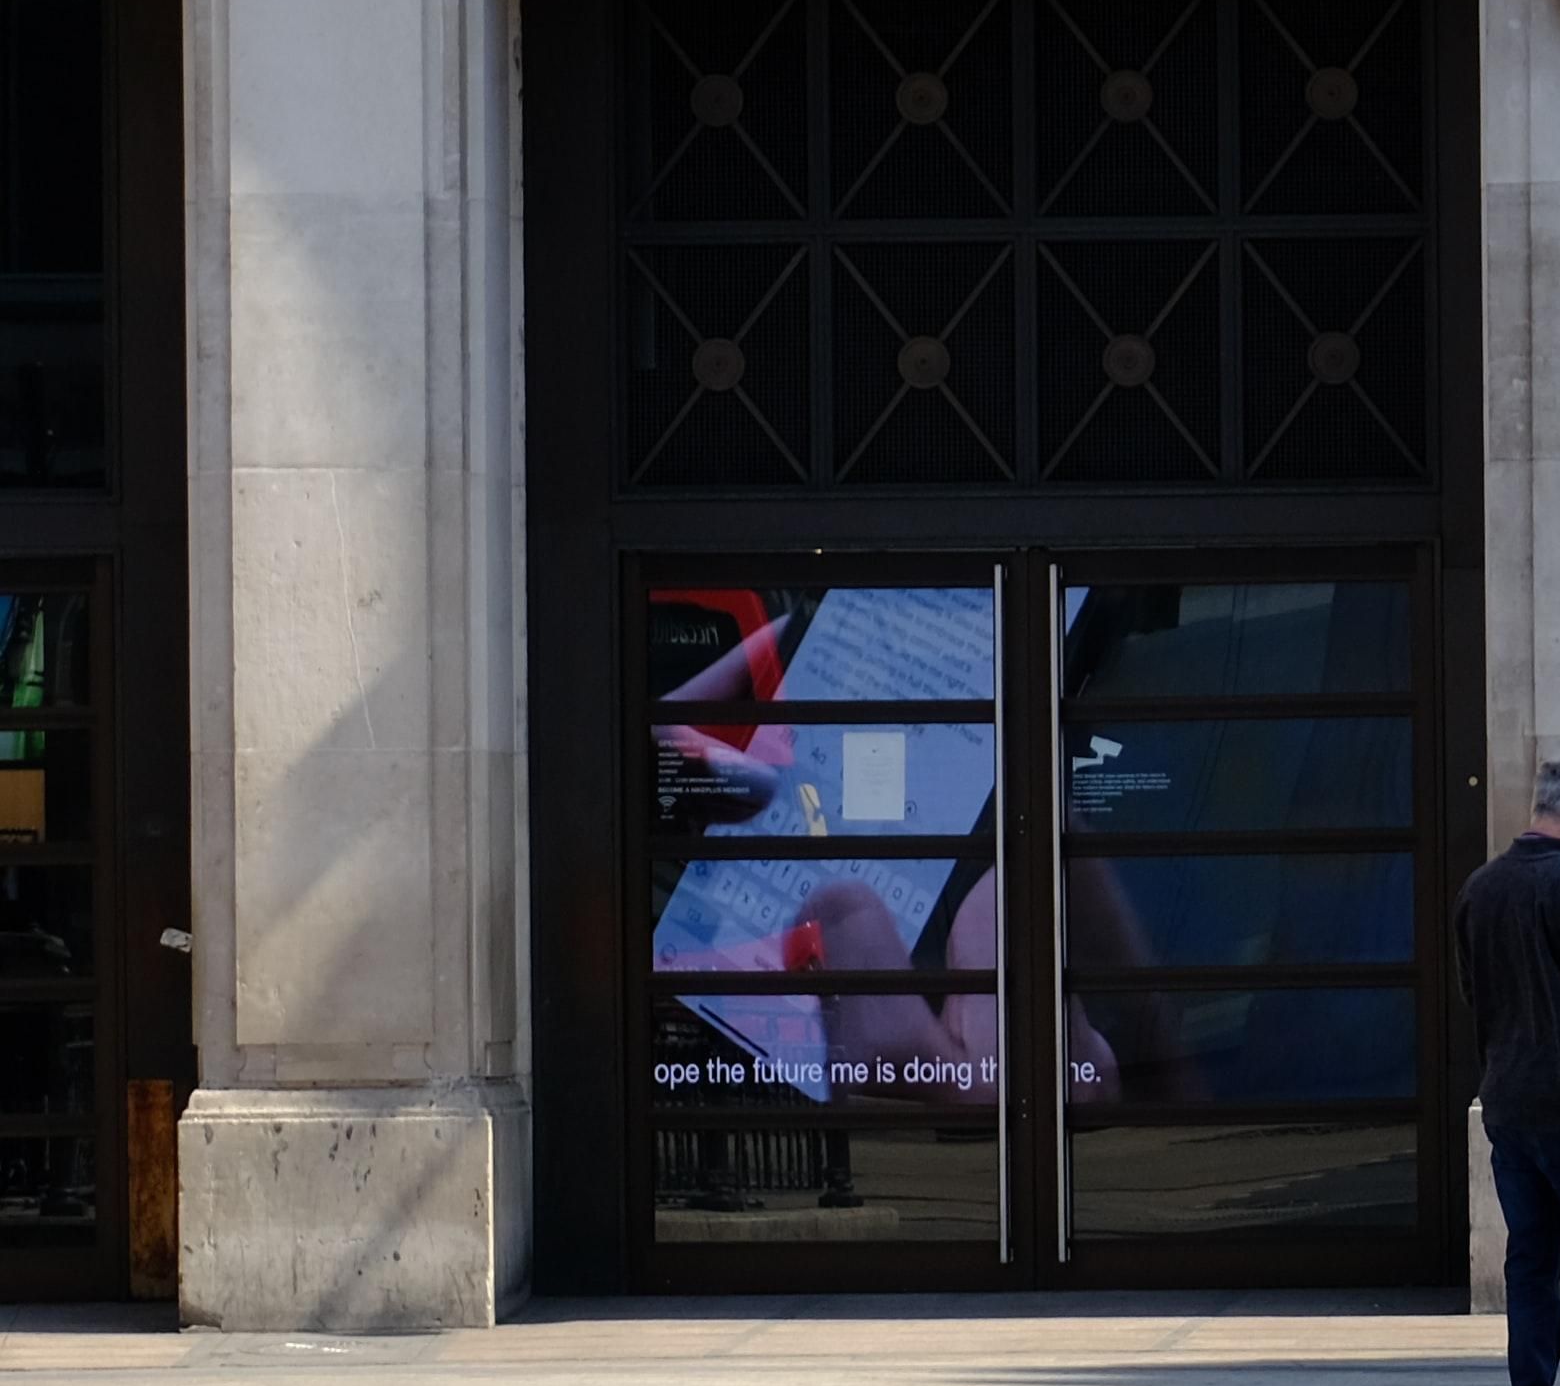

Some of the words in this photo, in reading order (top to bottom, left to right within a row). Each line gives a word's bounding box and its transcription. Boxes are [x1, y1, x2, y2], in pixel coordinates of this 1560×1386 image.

[654, 1062, 700, 1090] ope
[706, 1056, 745, 1083] the
[753, 1056, 823, 1083] future
[831, 1061, 868, 1083] me
[876, 1056, 896, 1083] is
[903, 1056, 972, 1091] doing
